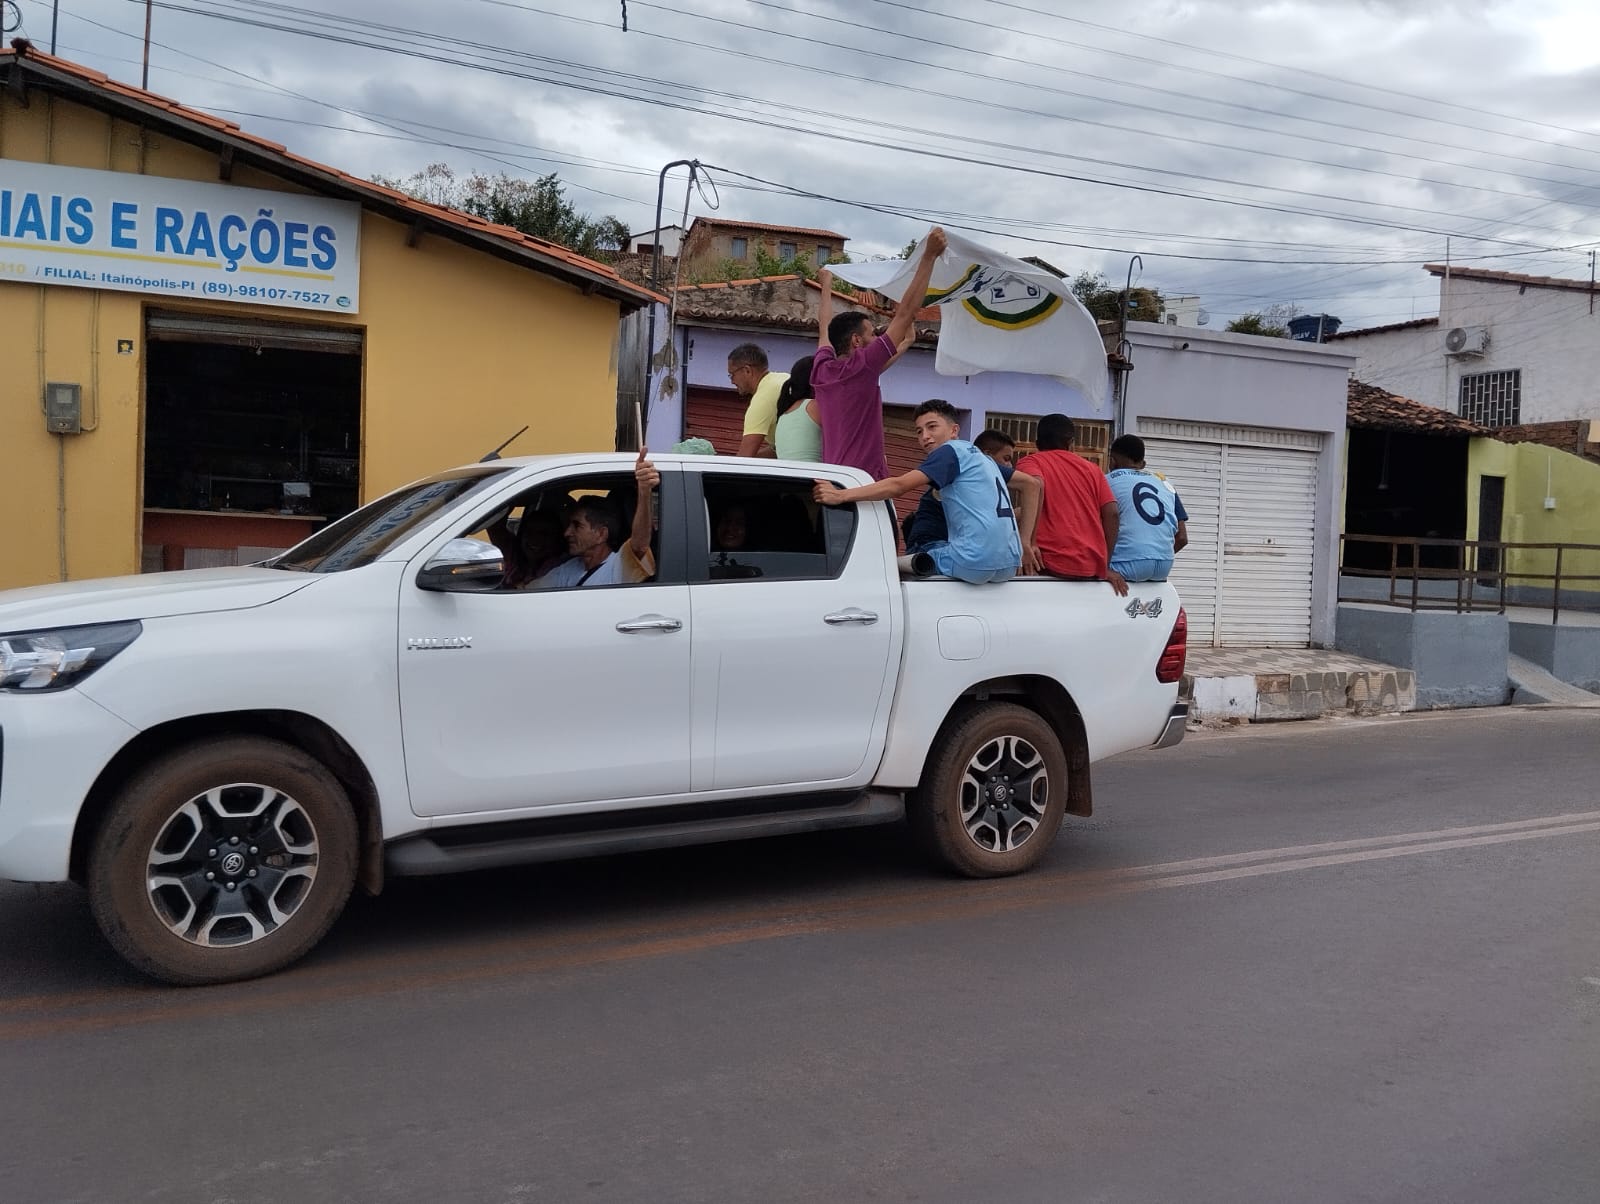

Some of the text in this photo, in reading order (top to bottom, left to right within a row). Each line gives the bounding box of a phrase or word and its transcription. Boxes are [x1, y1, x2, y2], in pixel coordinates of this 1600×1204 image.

[0, 190, 337, 272] IAIS E RAÇÕES
[44, 266, 96, 281] FILIAL:
[101, 272, 195, 291] Itainópolis-PI
[202, 281, 331, 305] (89)-98107-7527
[996, 476, 1016, 532] 4
[1132, 482, 1165, 526] 6
